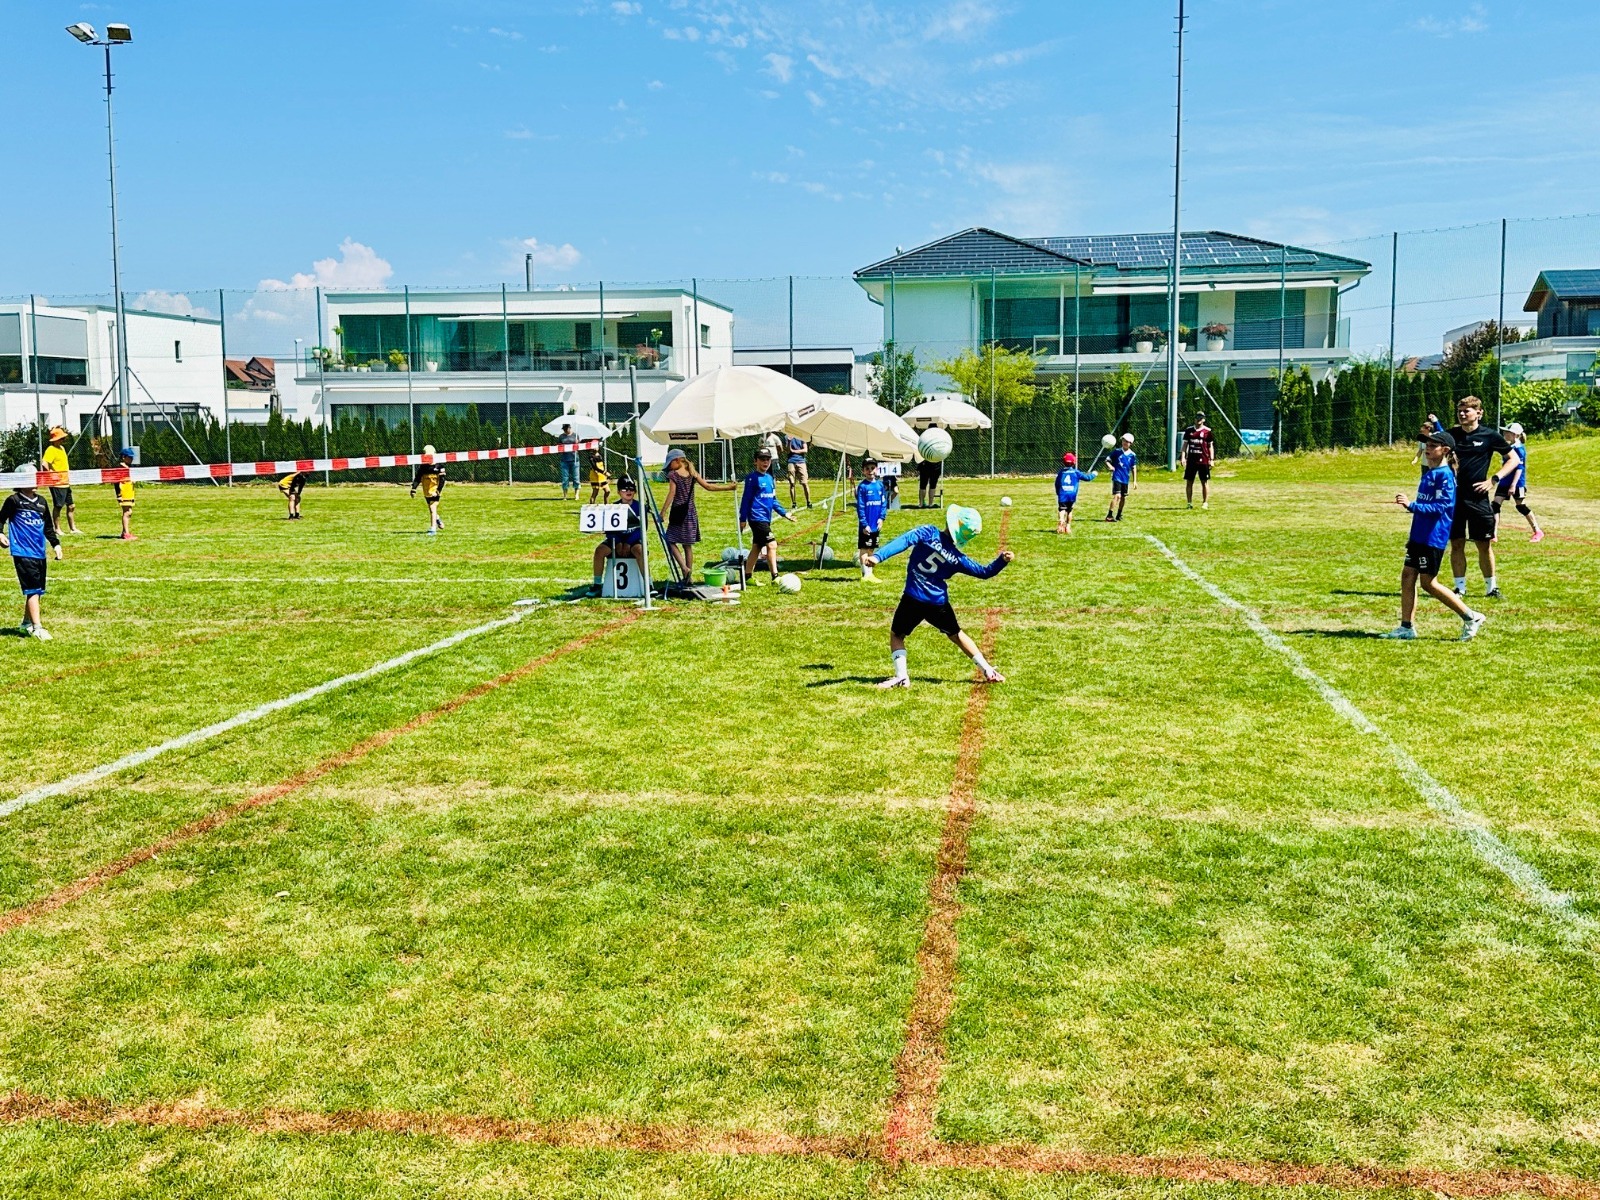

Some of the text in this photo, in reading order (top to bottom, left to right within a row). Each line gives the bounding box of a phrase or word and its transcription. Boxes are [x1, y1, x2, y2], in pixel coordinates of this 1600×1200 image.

[1064, 475, 1072, 485] 4
[586, 513, 620, 528] 3 6
[917, 551, 946, 573] 5
[1419, 556, 1428, 565] 13
[615, 562, 628, 590] 3
